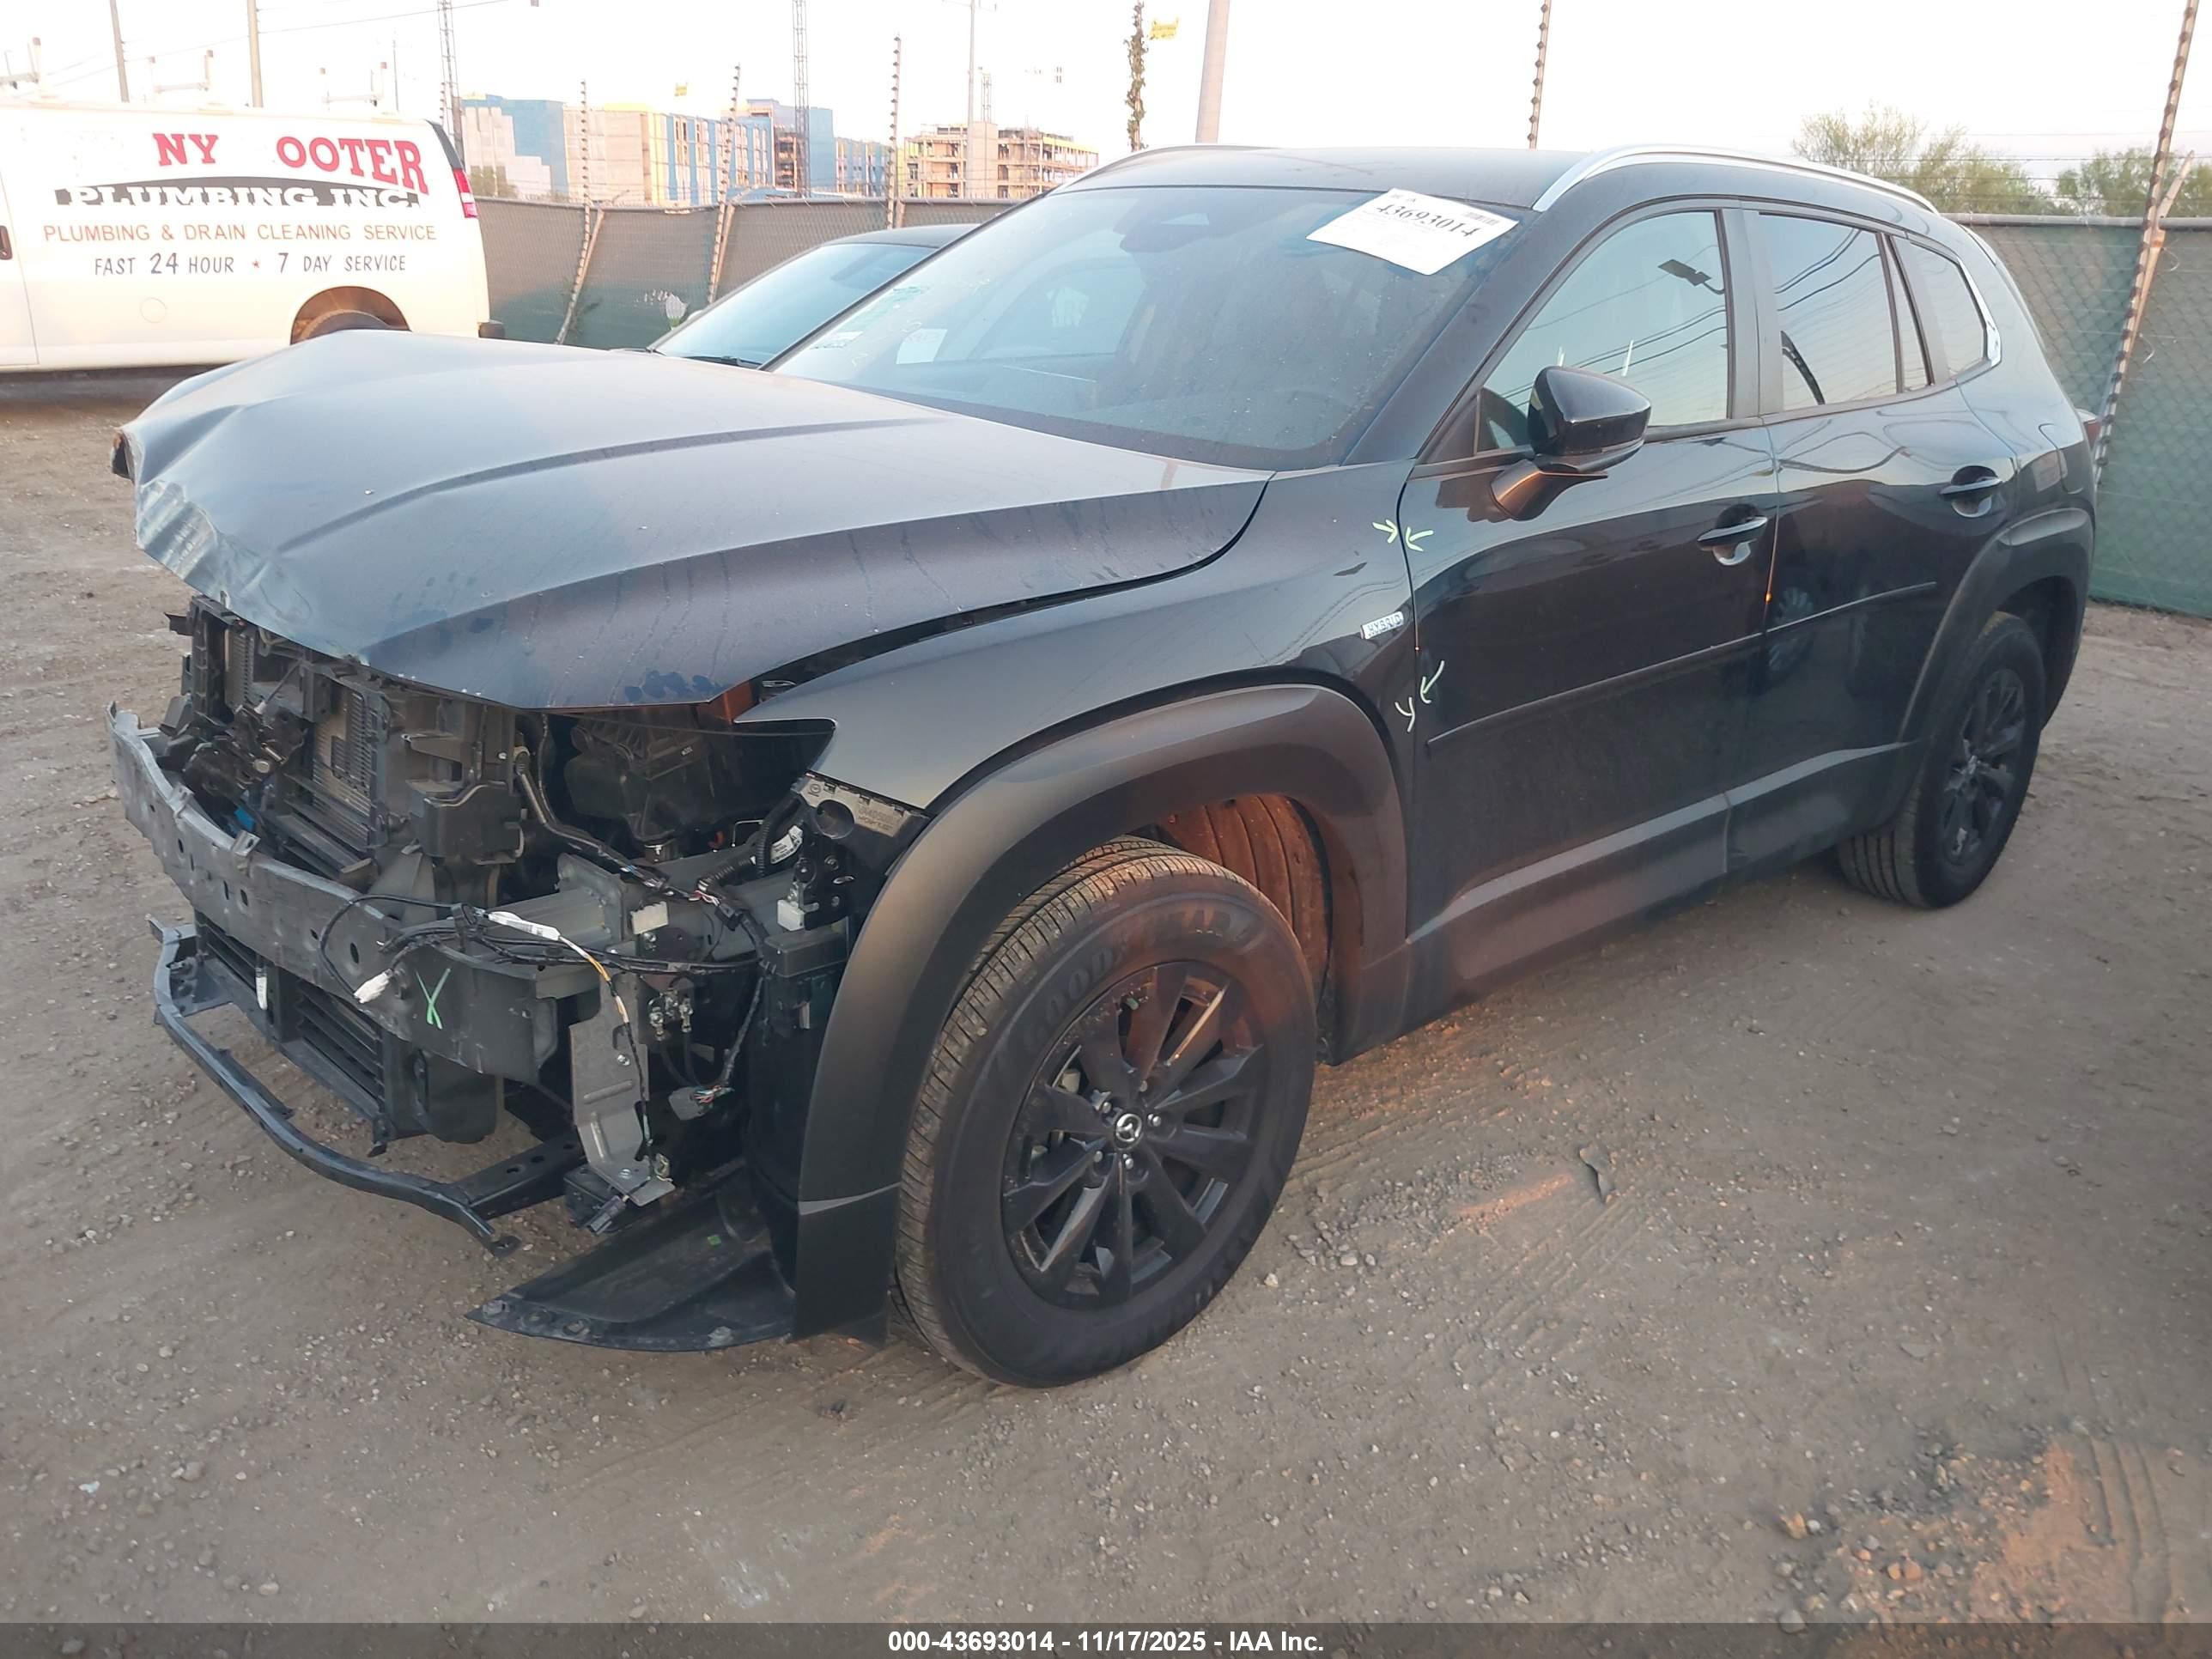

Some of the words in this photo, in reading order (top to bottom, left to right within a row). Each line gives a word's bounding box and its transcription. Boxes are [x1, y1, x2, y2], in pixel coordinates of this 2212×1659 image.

[152, 132, 220, 167] NY
[276, 136, 429, 196] OOTER
[68, 185, 320, 207] PLUMBING
[1376, 203, 1481, 238] 43693014
[43, 225, 150, 242] PLUMBING
[161, 224, 174, 241] &
[185, 224, 246, 241] DRAIN
[257, 224, 351, 240] CLEANING
[363, 224, 437, 240] SERVICE
[94, 257, 135, 276] FAST
[149, 252, 179, 275] 24
[188, 256, 234, 274] HOUR
[277, 252, 289, 274] 7
[303, 255, 333, 273] DAY
[344, 254, 406, 272] SERVICE
